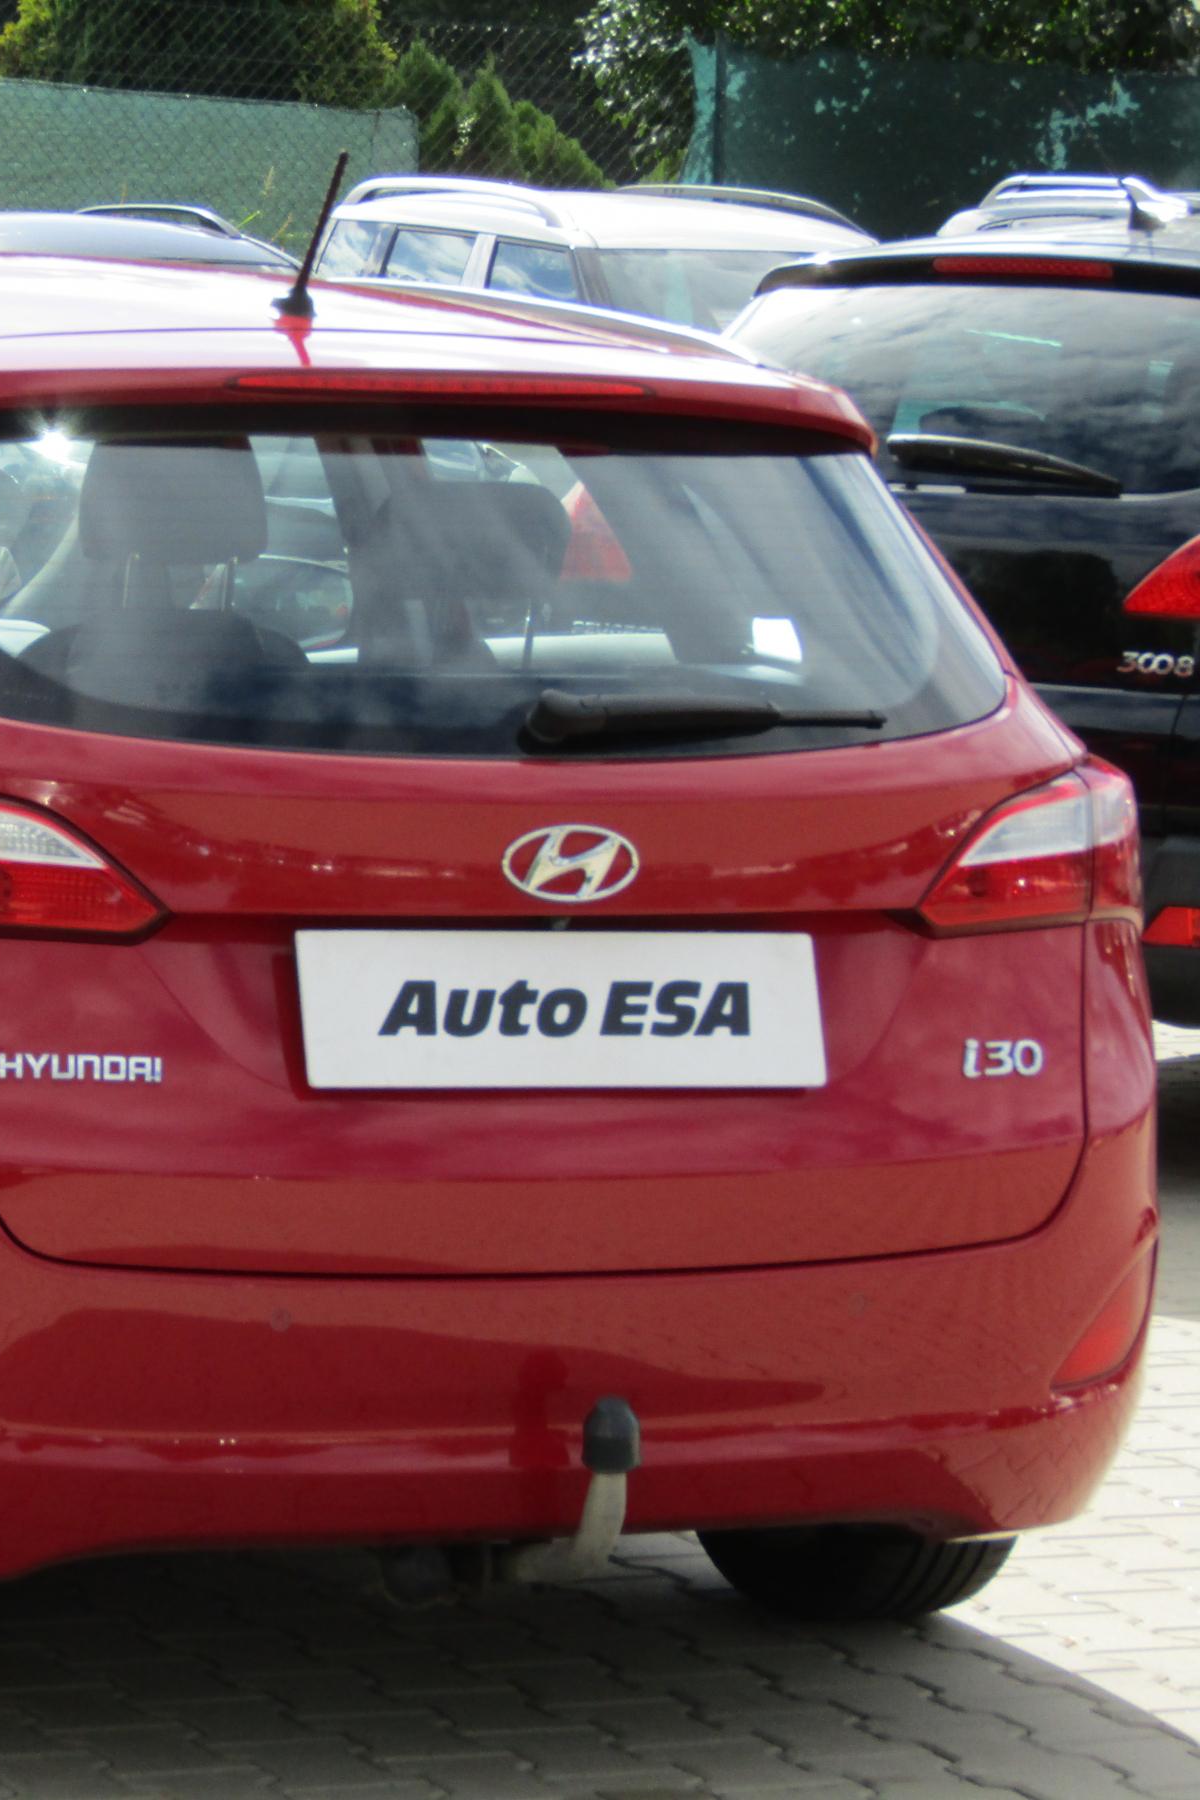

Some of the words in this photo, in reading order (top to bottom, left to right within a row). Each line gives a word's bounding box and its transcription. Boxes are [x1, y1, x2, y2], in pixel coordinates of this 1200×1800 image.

[1116, 651, 1195, 677] 3008
[378, 980, 588, 1037] Auto
[600, 980, 751, 1037] ESA
[963, 1038, 1044, 1078] i30
